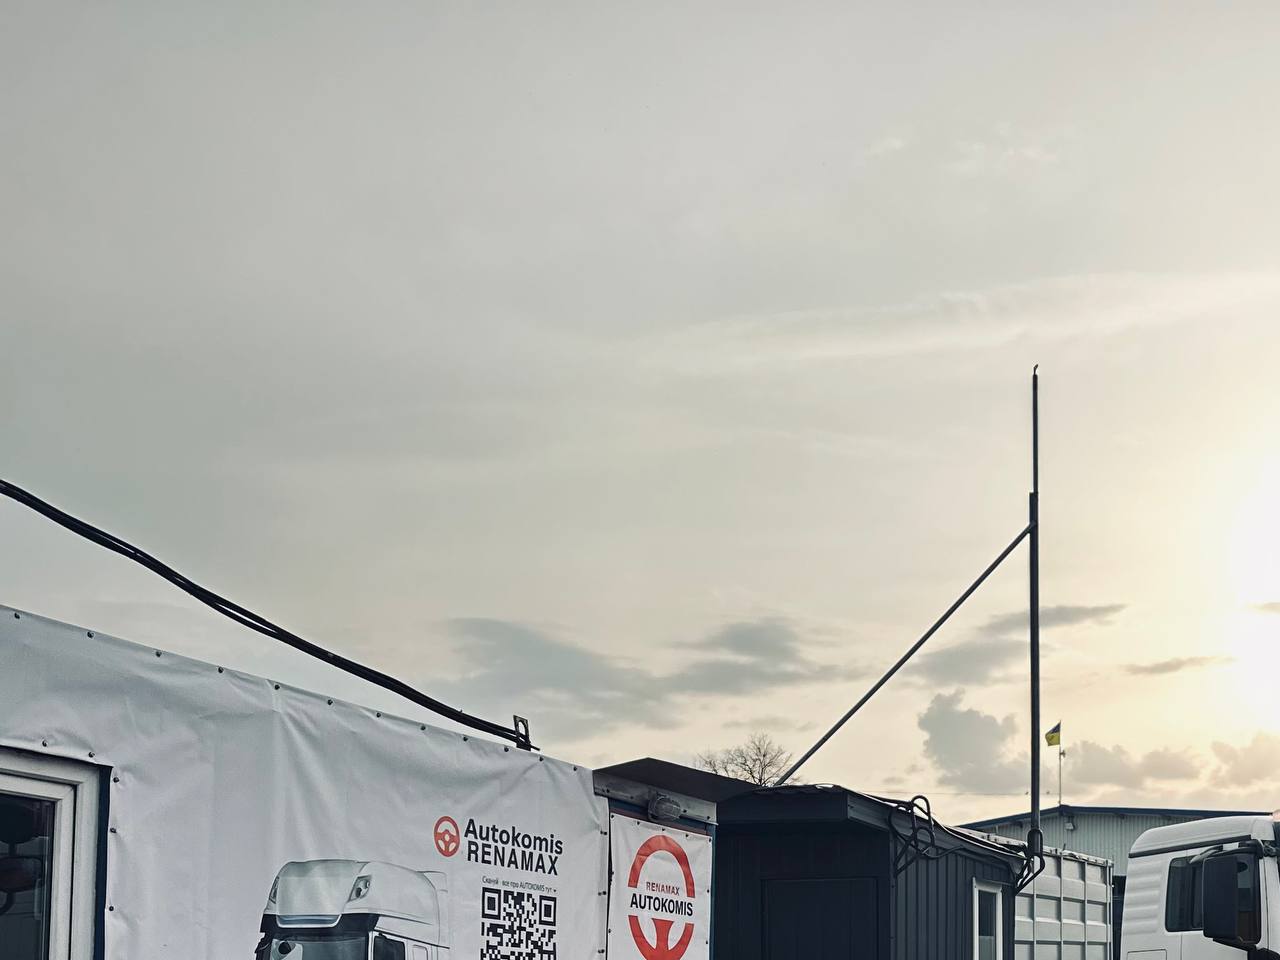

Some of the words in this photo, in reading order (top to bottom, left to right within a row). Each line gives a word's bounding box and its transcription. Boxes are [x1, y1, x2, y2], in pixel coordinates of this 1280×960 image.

[464, 818, 563, 855] Autokomis
[467, 840, 559, 876] RENAMAX
[646, 881, 680, 896] RENAMAX
[630, 893, 693, 917] AUTOKOMIS
